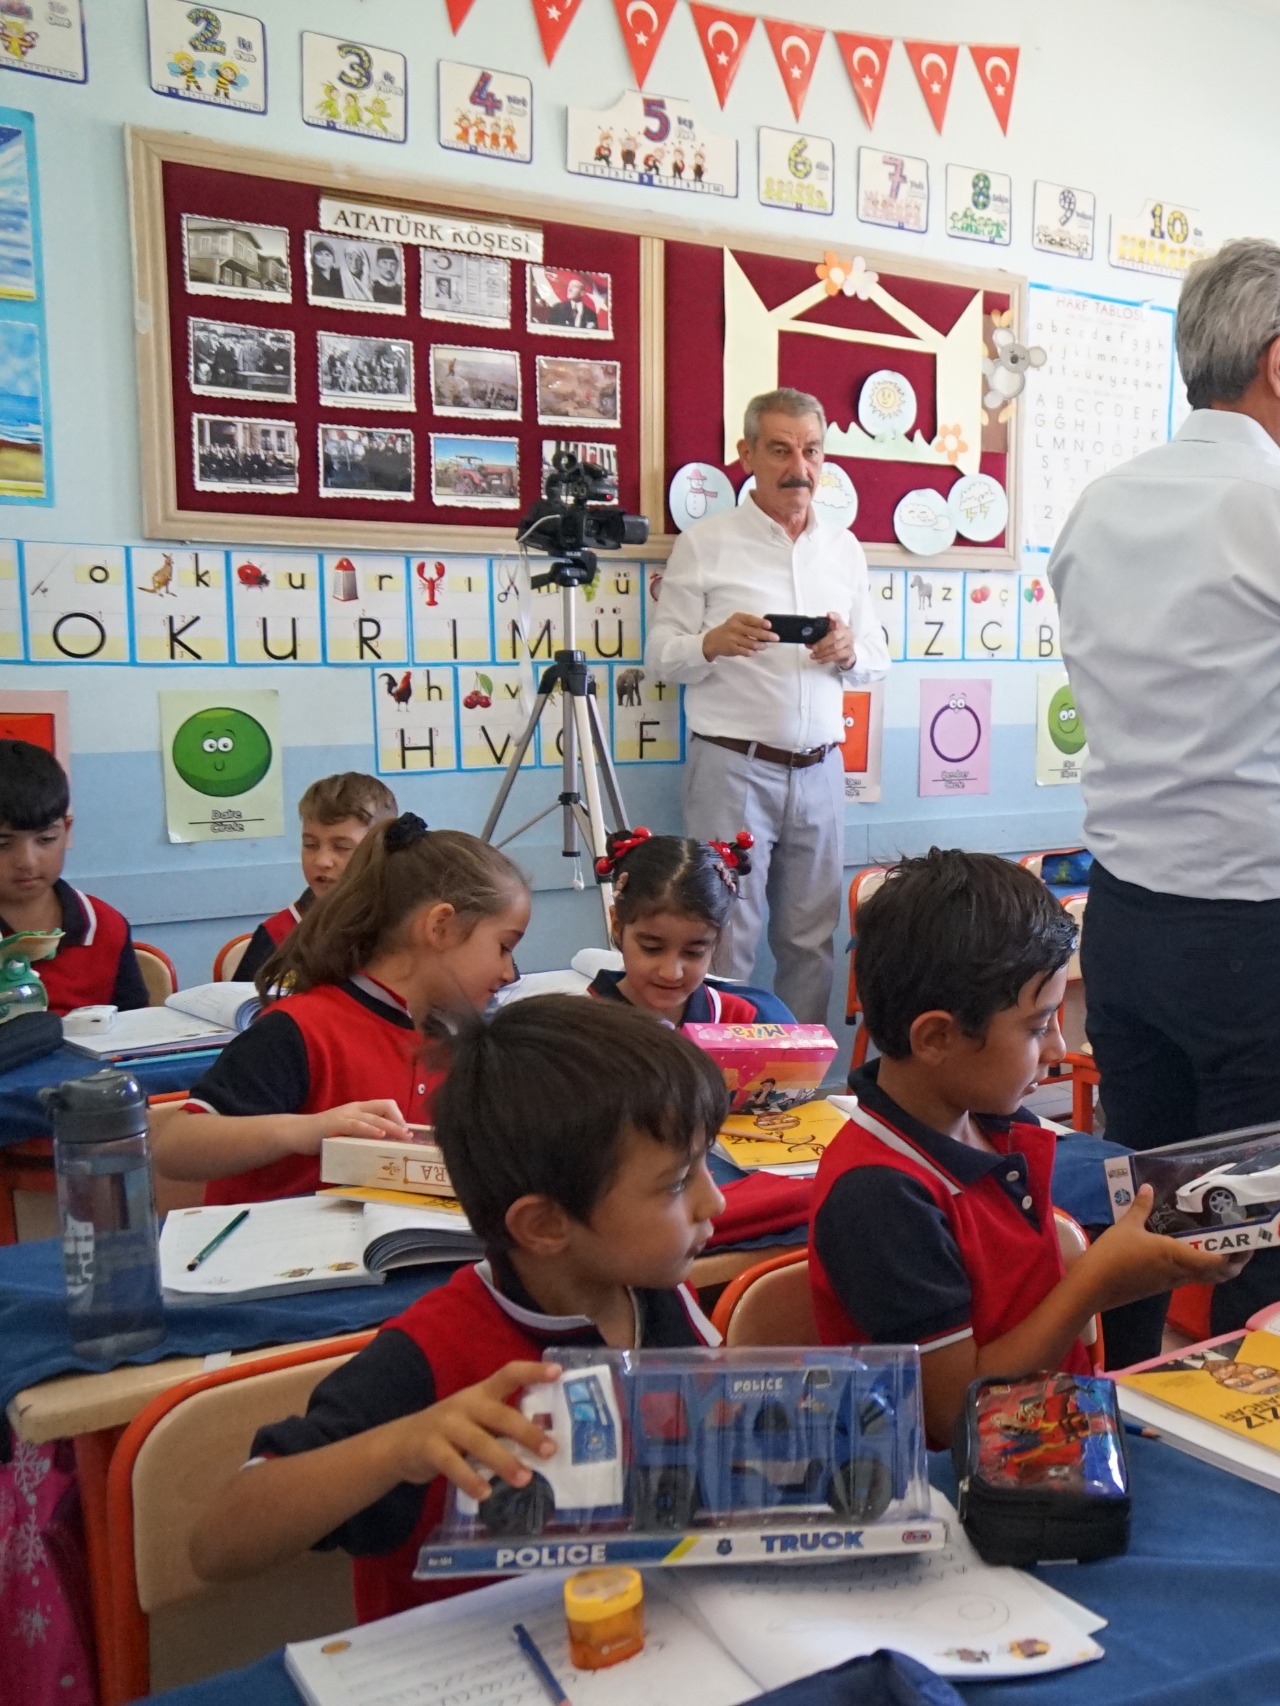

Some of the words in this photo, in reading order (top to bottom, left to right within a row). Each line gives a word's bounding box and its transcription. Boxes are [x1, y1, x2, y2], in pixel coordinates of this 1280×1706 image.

[187, 8, 227, 55] 2
[337, 43, 374, 90] 3
[469, 71, 503, 117] 4
[641, 97, 671, 142] 5
[788, 137, 812, 179] 6
[881, 155, 908, 200] 7
[971, 171, 992, 211] 8
[1059, 188, 1077, 227] 9
[333, 209, 442, 242] ATATÜRK
[451, 222, 531, 255] KÖŞESİ
[1150, 203, 1189, 244] 10
[1095, 302, 1146, 321] TABLOS
[88, 565, 110, 583] o
[195, 552, 210, 587] k
[288, 572, 305, 590] u
[378, 574, 394, 592] r
[615, 571, 630, 595] ü
[881, 573, 893, 600] d
[941, 587, 952, 601] z
[52, 612, 106, 659] O
[168, 615, 202, 660] K
[262, 617, 297, 660] U
[358, 617, 382, 660] R
[511, 619, 551, 660] M
[594, 607, 624, 659] Ü
[924, 622, 944, 656] Z
[1038, 624, 1054, 658] B
[426, 669, 443, 701] h
[400, 727, 434, 769] H
[481, 725, 511, 765] V
[640, 721, 661, 759] F
[211, 809, 242, 820] Daire
[420, 1165, 448, 1182] RA
[1189, 1233, 1250, 1251] TCAR
[733, 1377, 783, 1392] POLICE
[496, 1543, 607, 1568] POLICE
[761, 1531, 864, 1553] TRUCK
